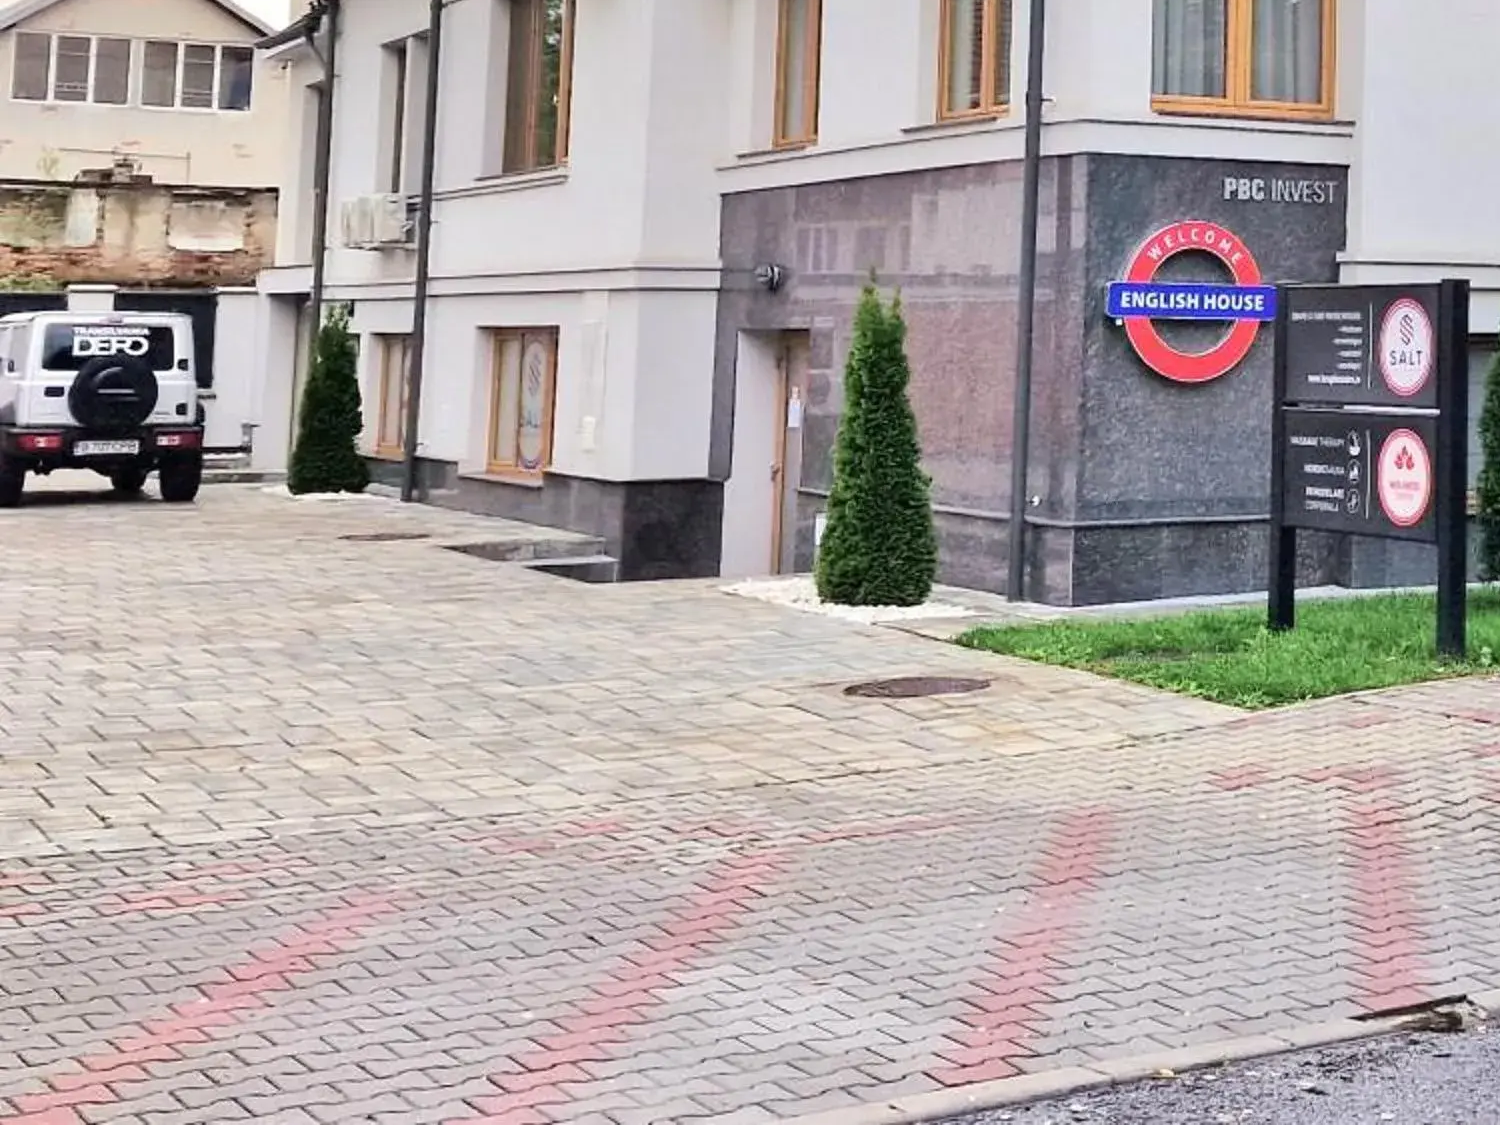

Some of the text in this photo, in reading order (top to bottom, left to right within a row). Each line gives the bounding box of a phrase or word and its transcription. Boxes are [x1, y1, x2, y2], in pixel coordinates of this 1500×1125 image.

[1223, 178, 1339, 204] PBC INVEST
[1147, 227, 1245, 265] WELCOME
[1120, 291, 1265, 311] ENGLISH HOUSE
[1389, 350, 1423, 366] SALT
